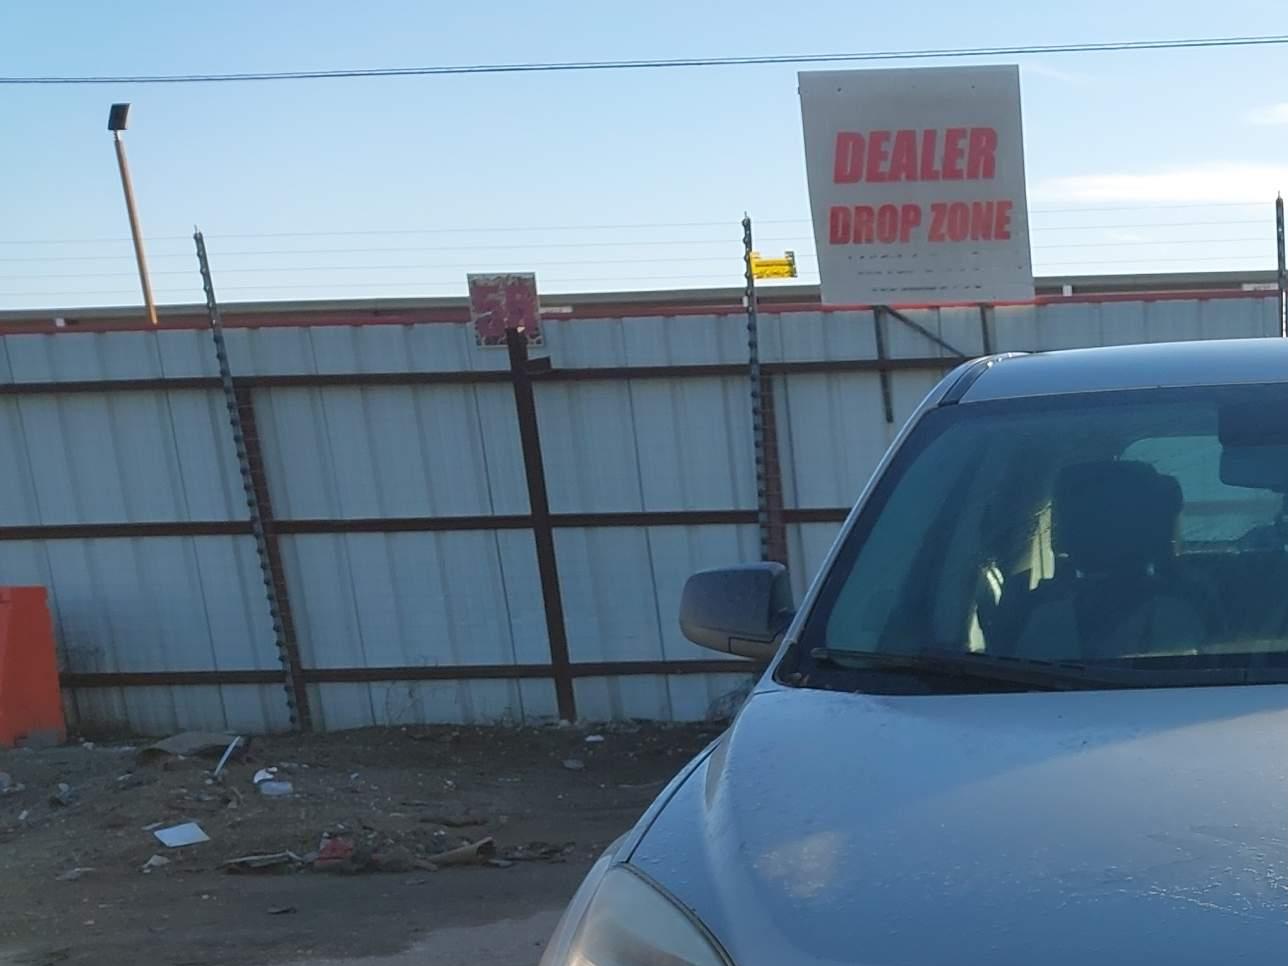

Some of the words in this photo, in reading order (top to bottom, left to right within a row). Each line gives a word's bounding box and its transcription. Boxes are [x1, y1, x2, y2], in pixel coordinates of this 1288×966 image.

[833, 127, 998, 184] DEALER
[828, 203, 922, 245] DROP
[928, 200, 1013, 242] ZONE
